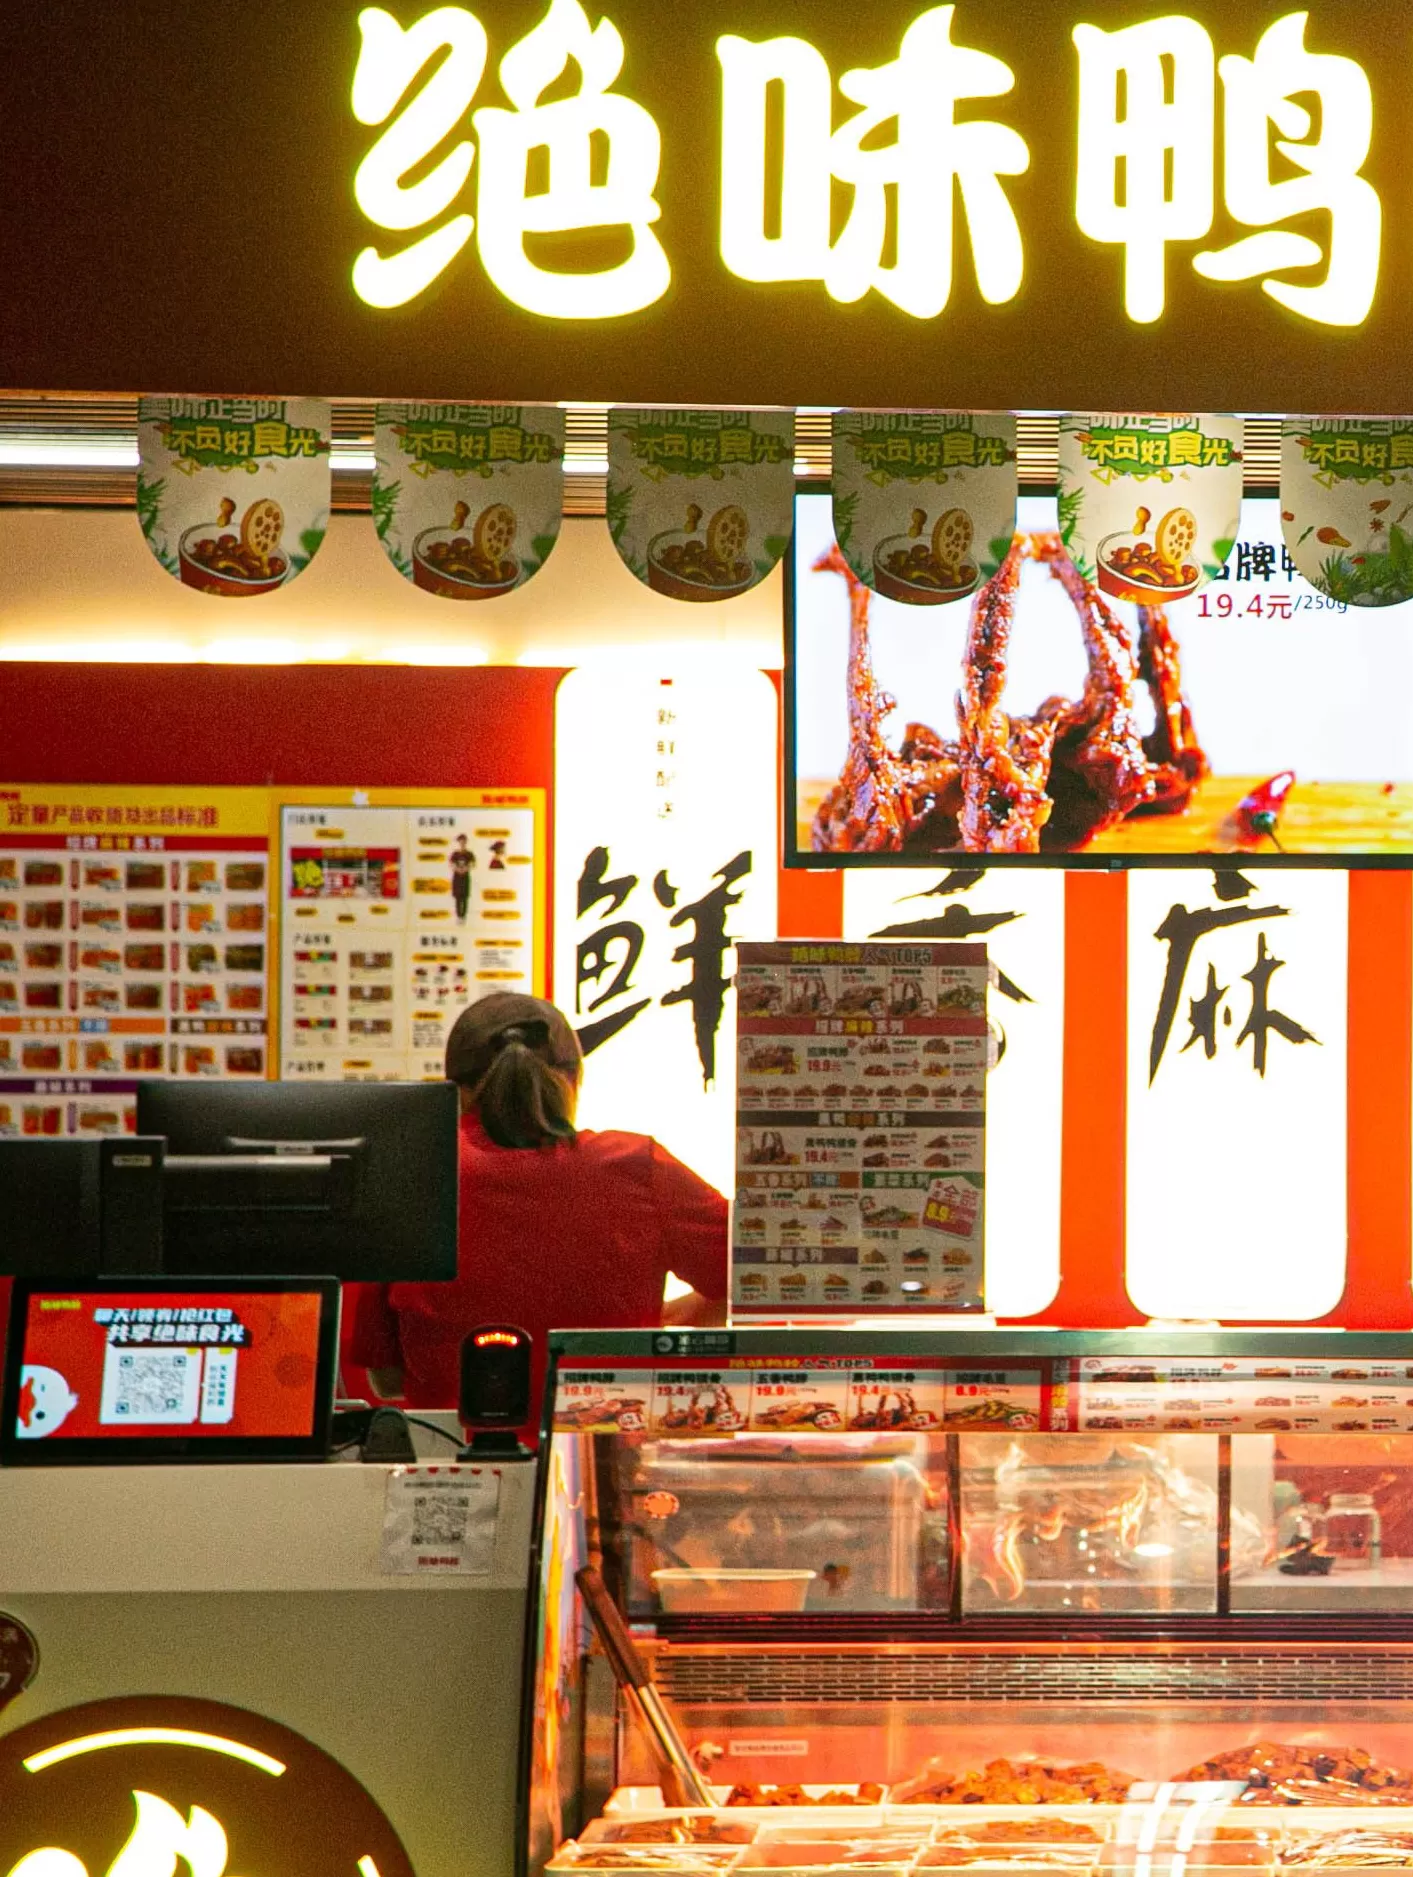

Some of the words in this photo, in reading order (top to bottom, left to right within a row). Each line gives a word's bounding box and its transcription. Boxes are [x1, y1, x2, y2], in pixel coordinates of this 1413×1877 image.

[1091, 431, 1228, 466] 不负好食光
